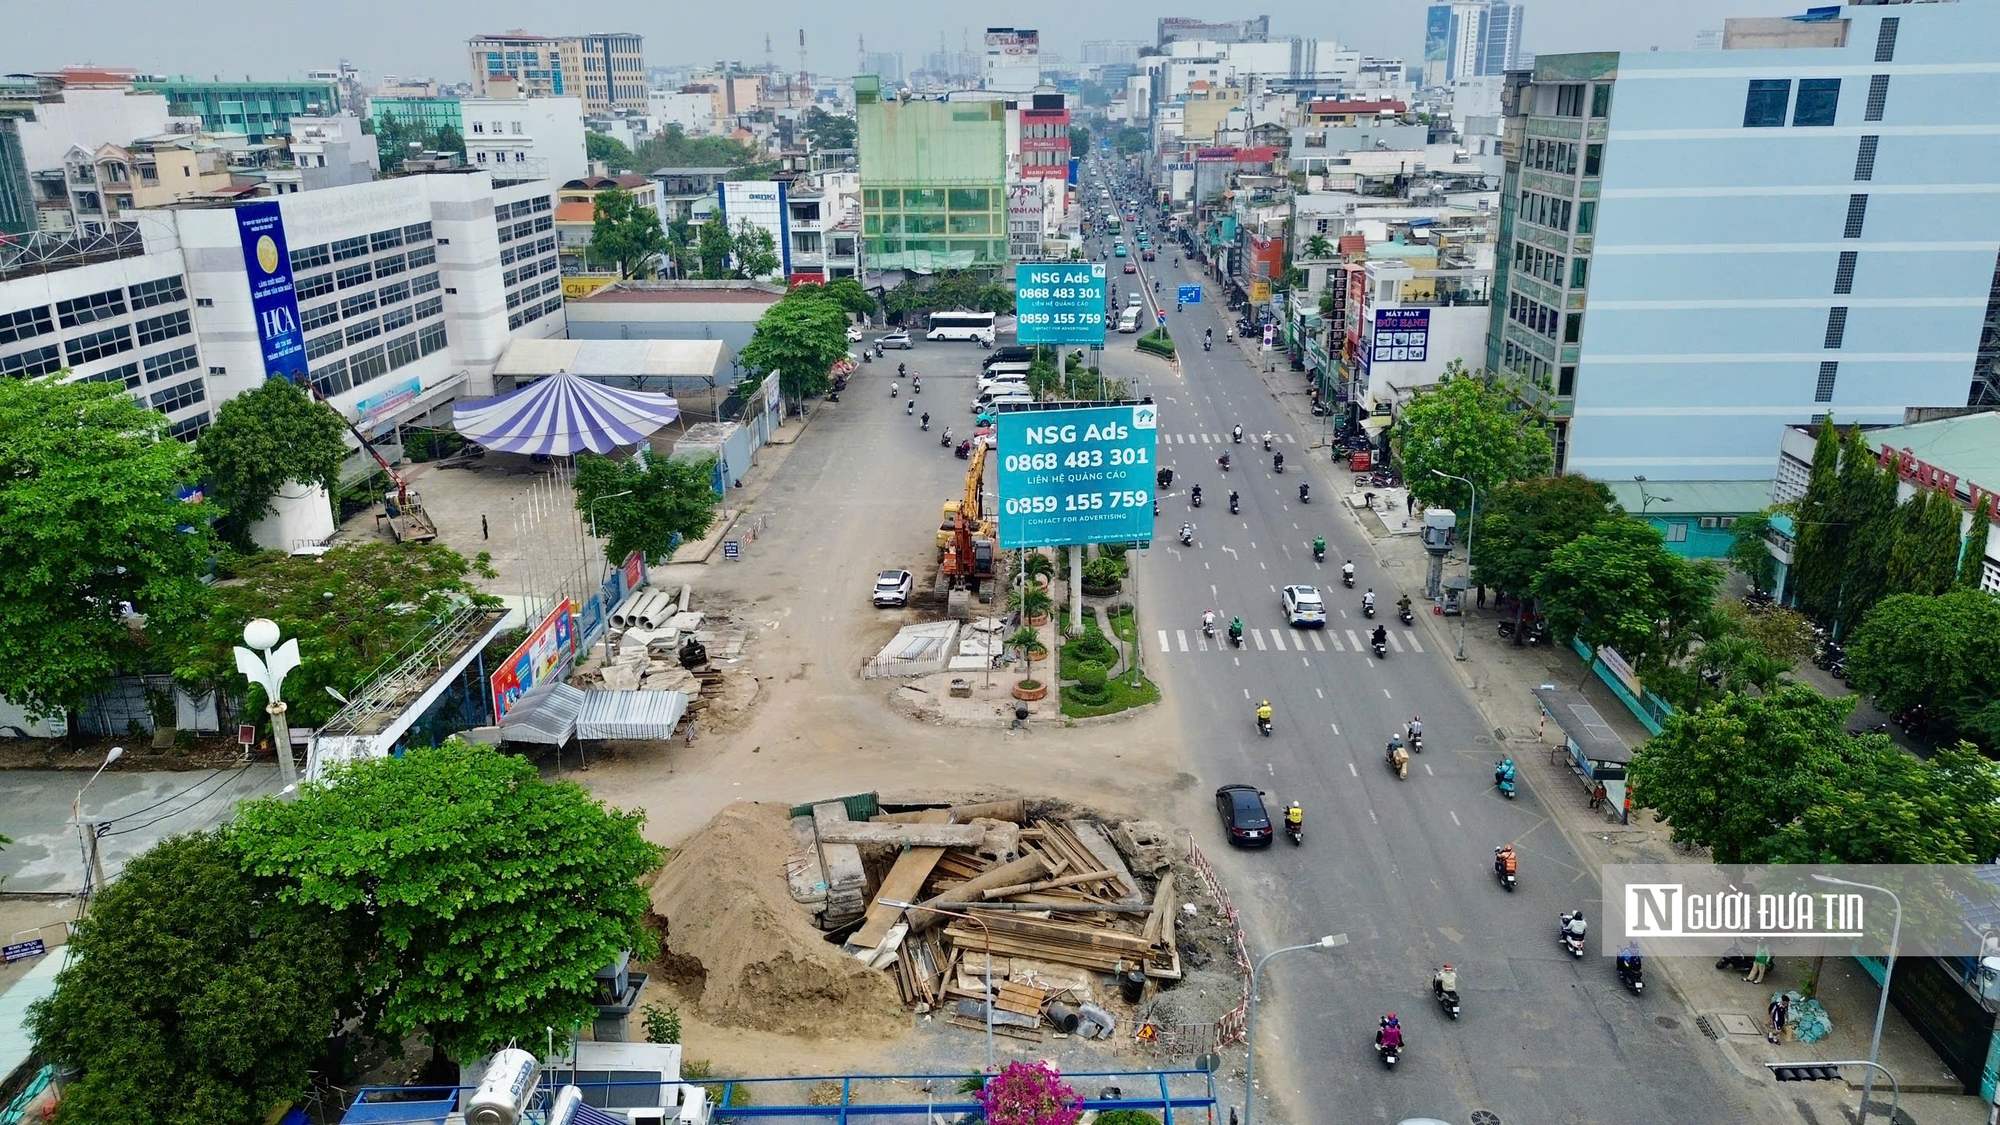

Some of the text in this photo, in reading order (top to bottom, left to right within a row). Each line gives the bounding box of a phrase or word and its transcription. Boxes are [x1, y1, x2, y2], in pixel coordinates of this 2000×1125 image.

[1031, 272, 1090, 284] NSG Ads
[1019, 288, 1101, 299] 0868 483 301
[261, 305, 296, 338] HCA
[1020, 313, 1101, 324] 0859 155 759
[1376, 318, 1428, 328] ĐỨC HẠNH
[1026, 421, 1129, 445] NSG Ads
[1005, 447, 1149, 472] 0868 483 301
[1027, 469, 1127, 485] LIÊN HỆ QUẢNG CÁO
[1005, 490, 1148, 515] 0859 155 759
[1028, 517, 1061, 525] CONTACT
[1079, 513, 1127, 522] ADVERTISING
